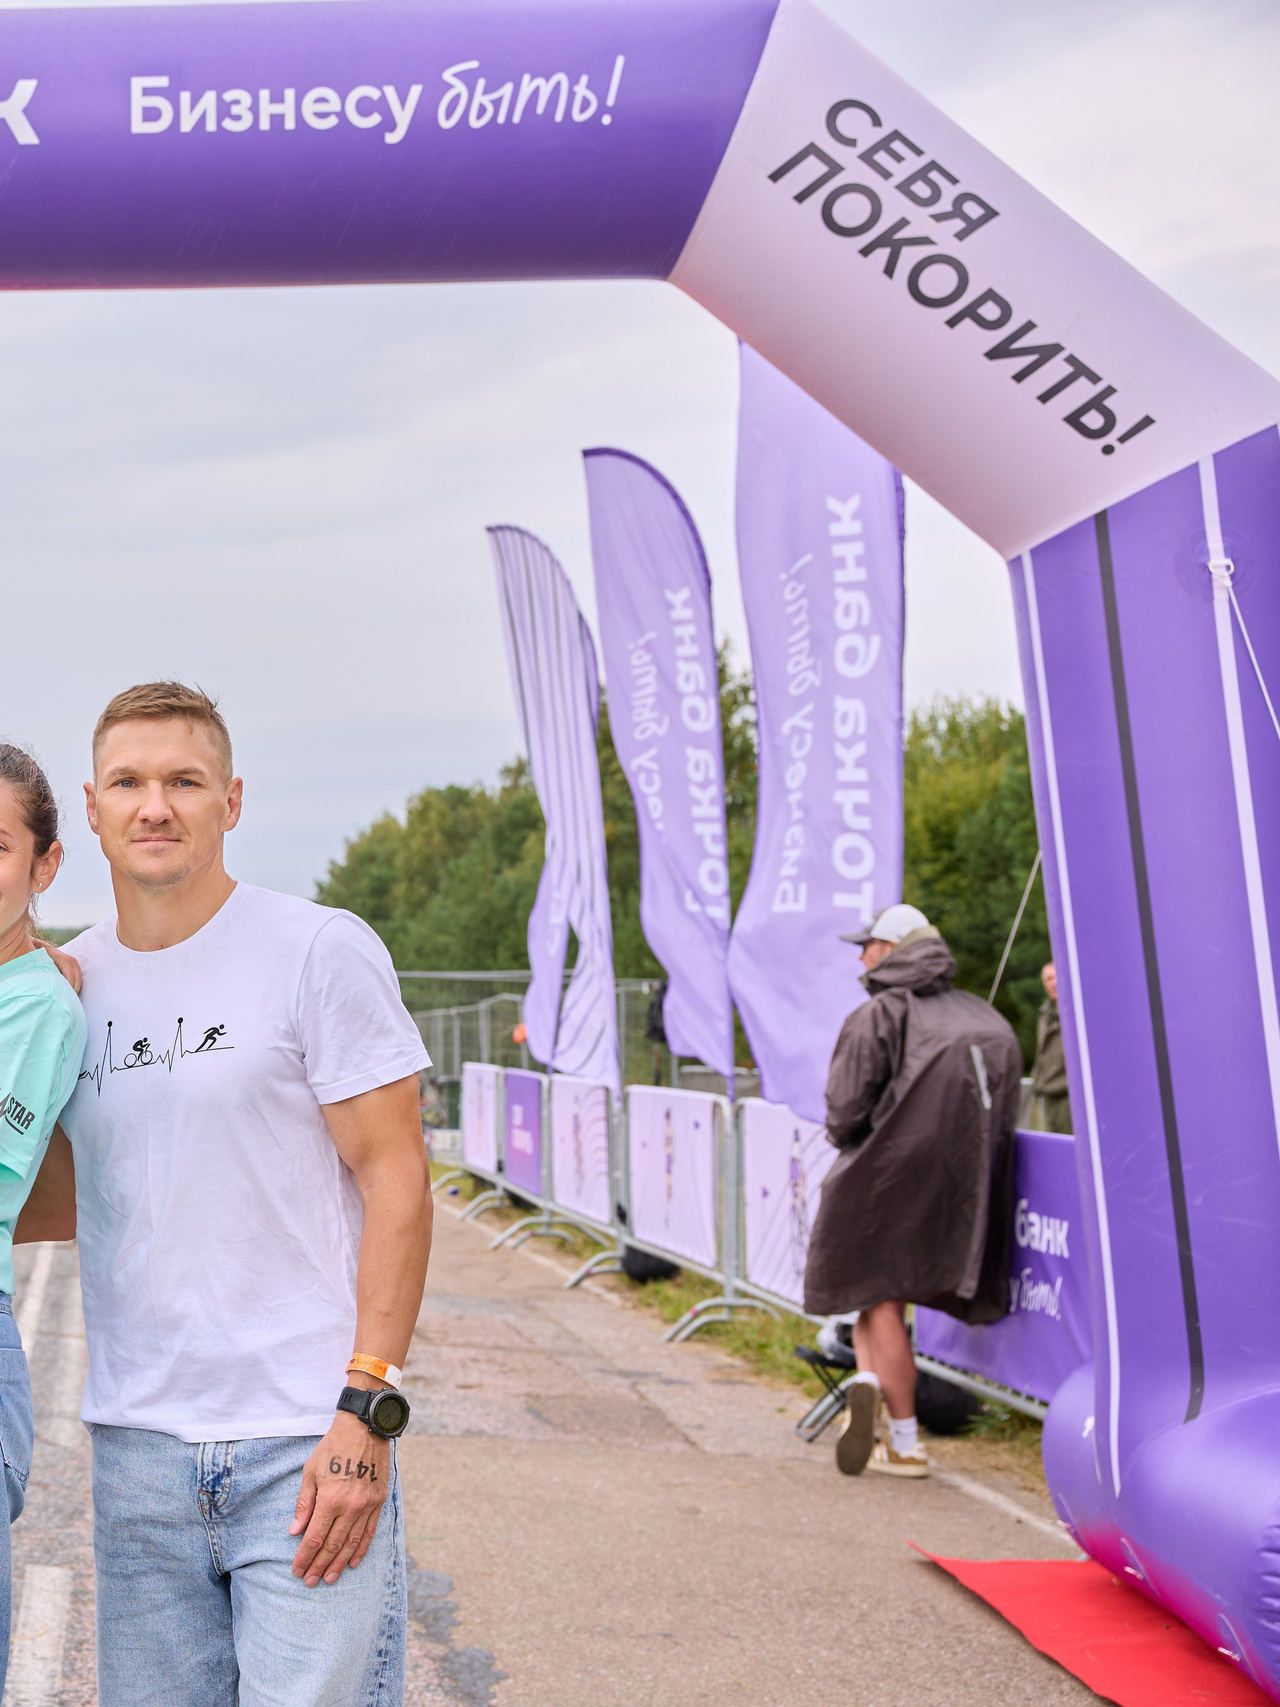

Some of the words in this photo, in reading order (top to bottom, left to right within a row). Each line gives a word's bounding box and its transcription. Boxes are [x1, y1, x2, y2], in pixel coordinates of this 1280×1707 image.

[130, 75, 423, 144] Бизнесу
[436, 54, 625, 129] быть!
[825, 99, 1000, 242] СЕБЯ
[767, 142, 1156, 456] ПОКОРИТЬ!
[7, 1096, 36, 1130] STAR
[1014, 1198, 1070, 1259] банк
[329, 1454, 378, 1483] 1419
